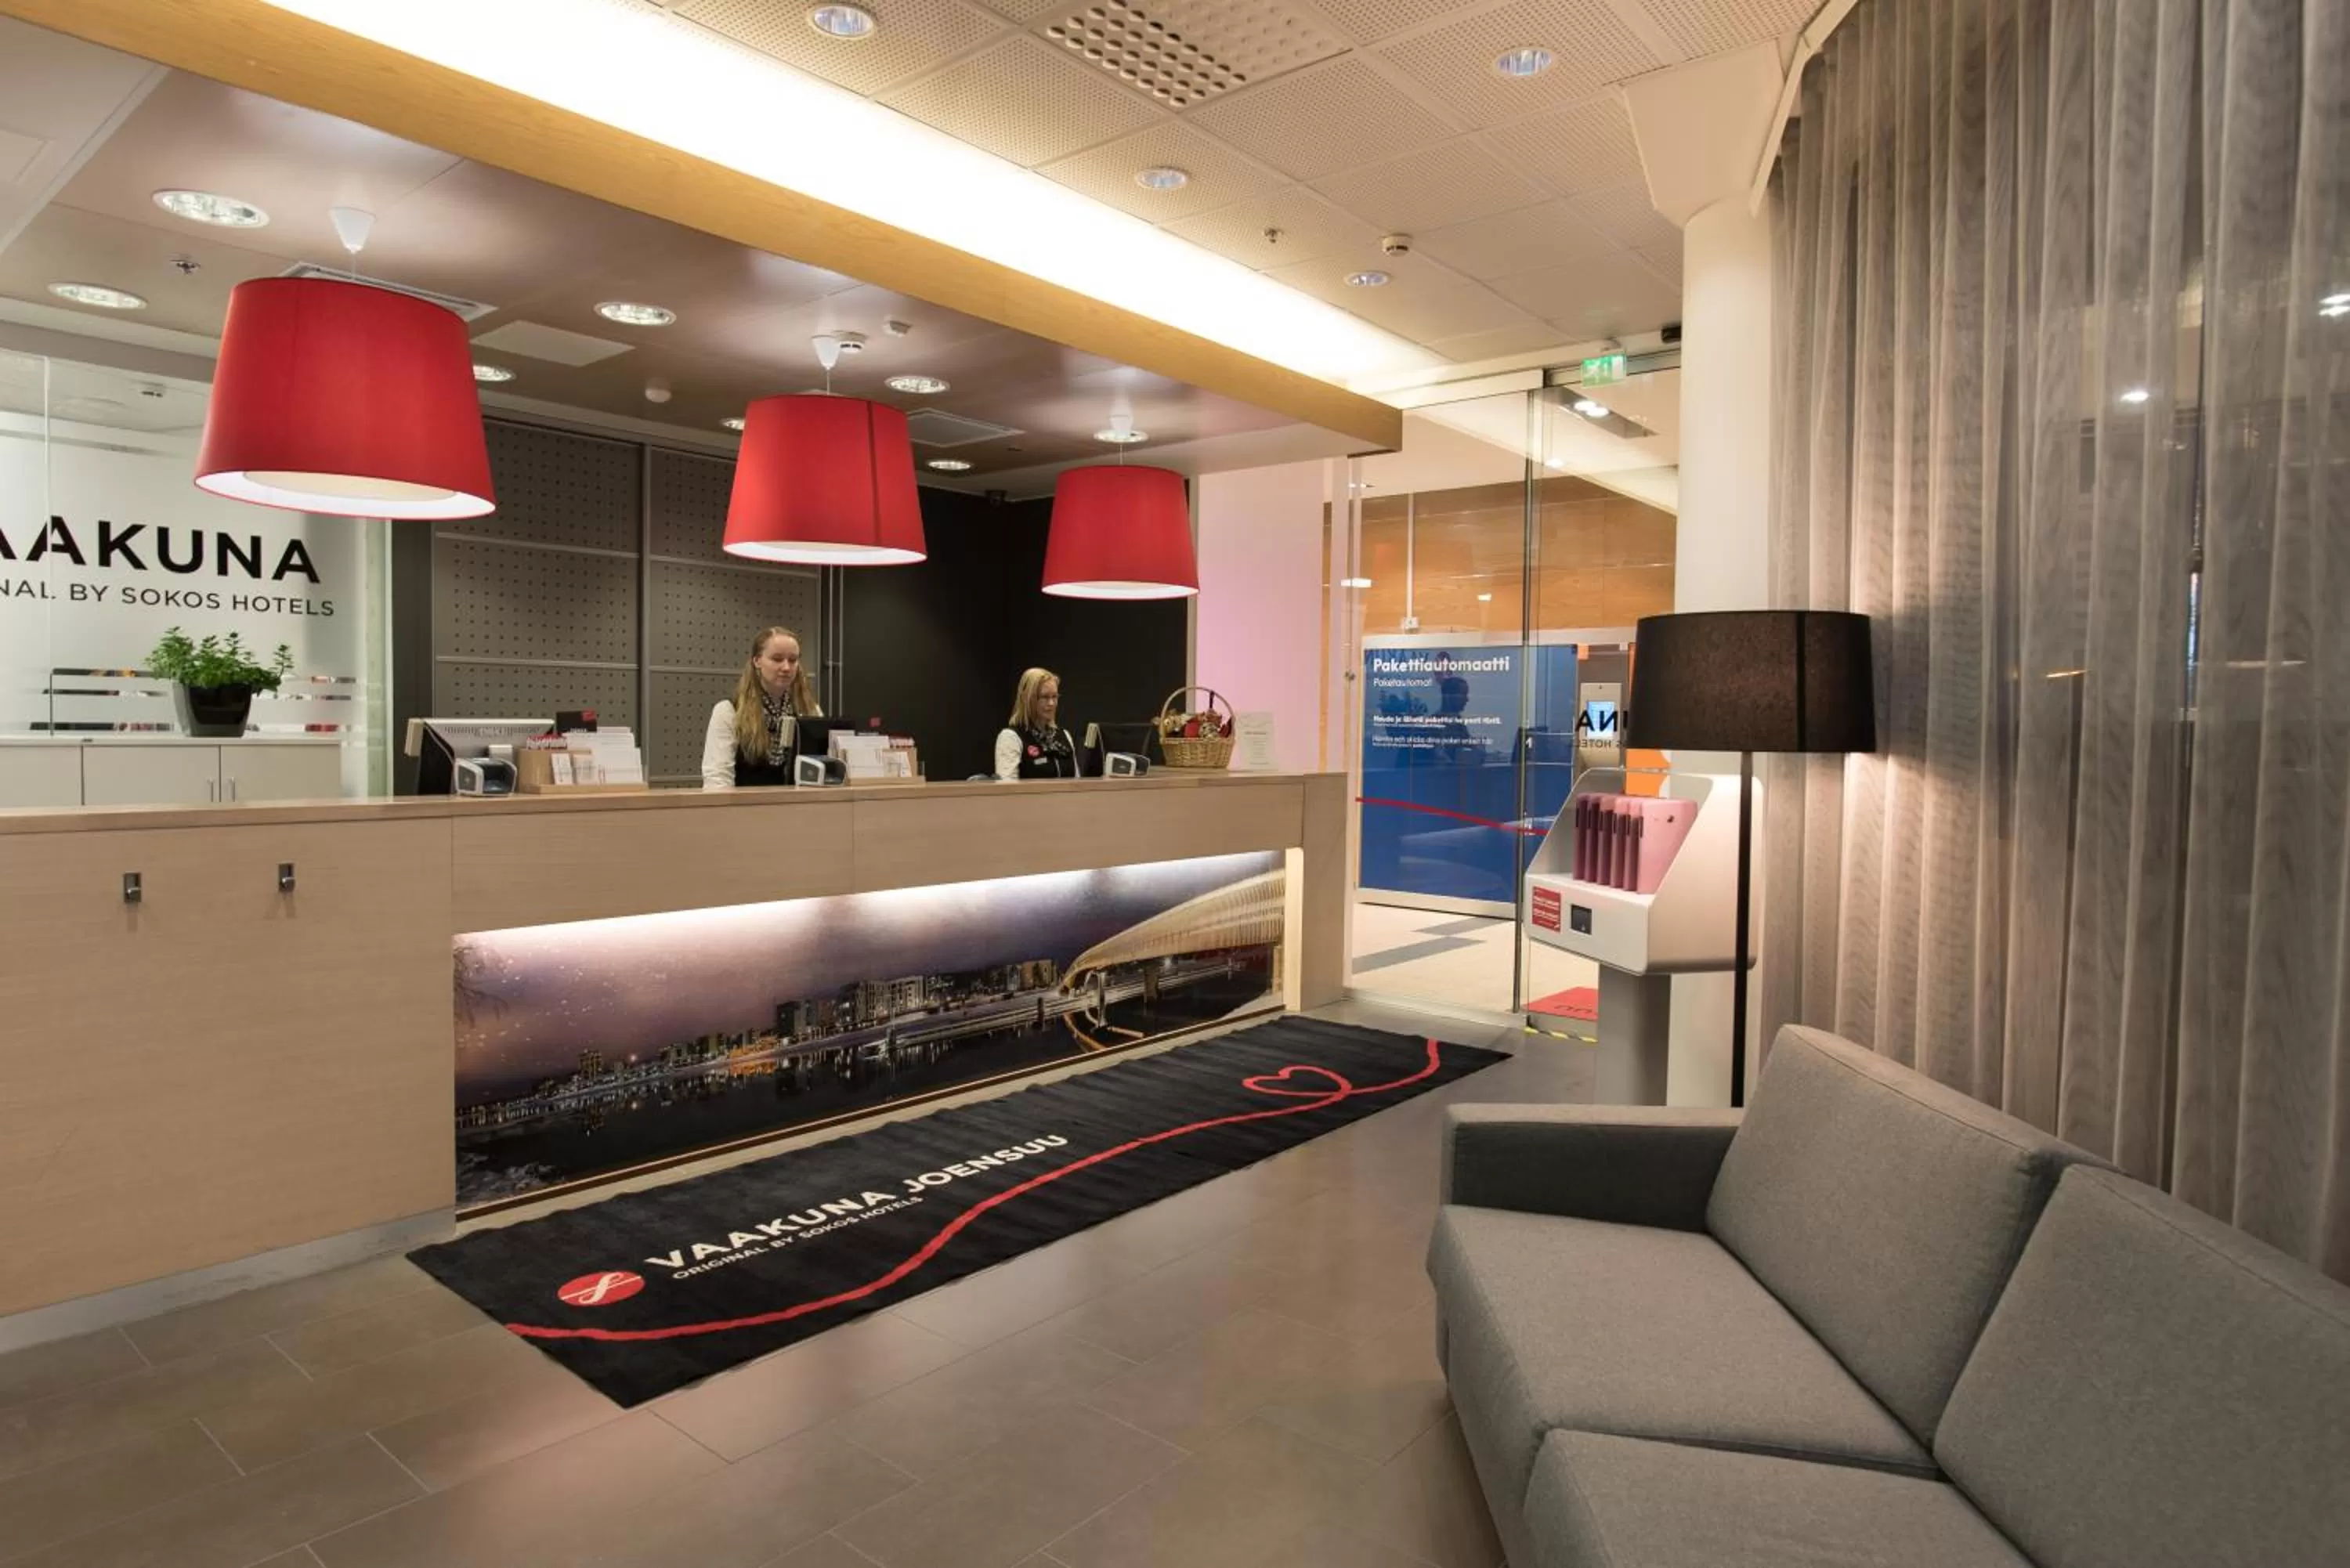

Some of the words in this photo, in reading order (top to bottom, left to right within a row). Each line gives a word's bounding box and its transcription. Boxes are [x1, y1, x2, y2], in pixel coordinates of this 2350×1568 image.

[70, 583, 109, 602] BY
[121, 587, 220, 609] SOKOS
[232, 594, 334, 616] HOTELS
[1373, 656, 1509, 673] Pakettiautomaatti
[644, 1190, 896, 1268] VAAKUNA
[903, 1135, 1068, 1193] JOENSUU
[672, 1247, 769, 1279] ORIGINAL
[769, 1235, 794, 1248] BY
[798, 1216, 859, 1238] SOKOS
[859, 1196, 924, 1219] HOTELS
